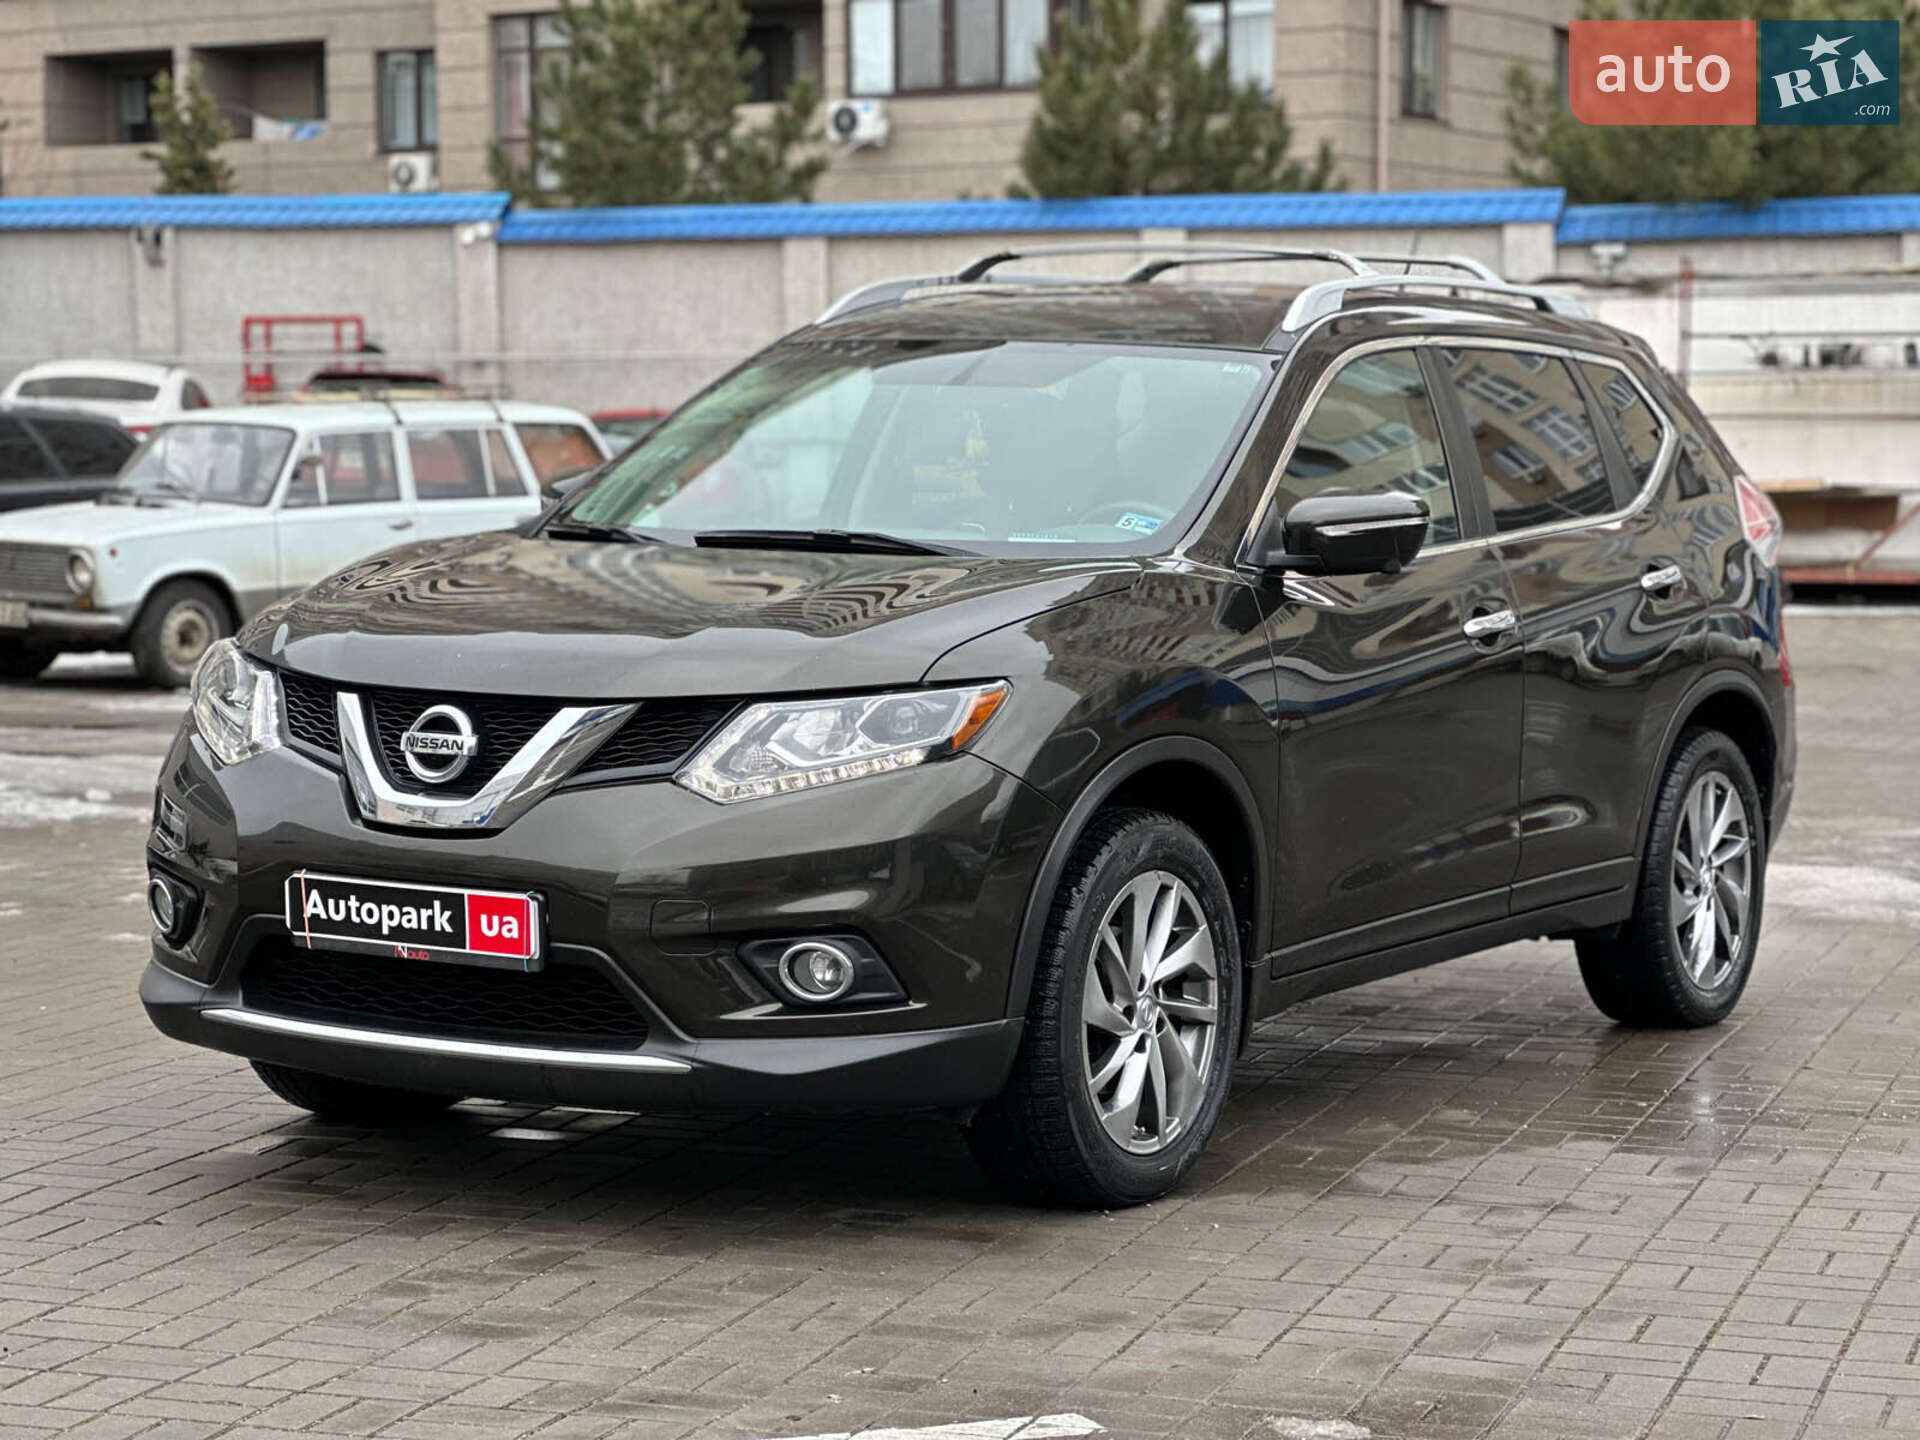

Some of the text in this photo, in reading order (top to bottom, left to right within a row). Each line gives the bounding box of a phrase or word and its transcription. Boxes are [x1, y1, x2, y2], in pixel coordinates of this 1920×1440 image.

[406, 736, 464, 751] NISSAN
[305, 889, 519, 939] Autopark ua
